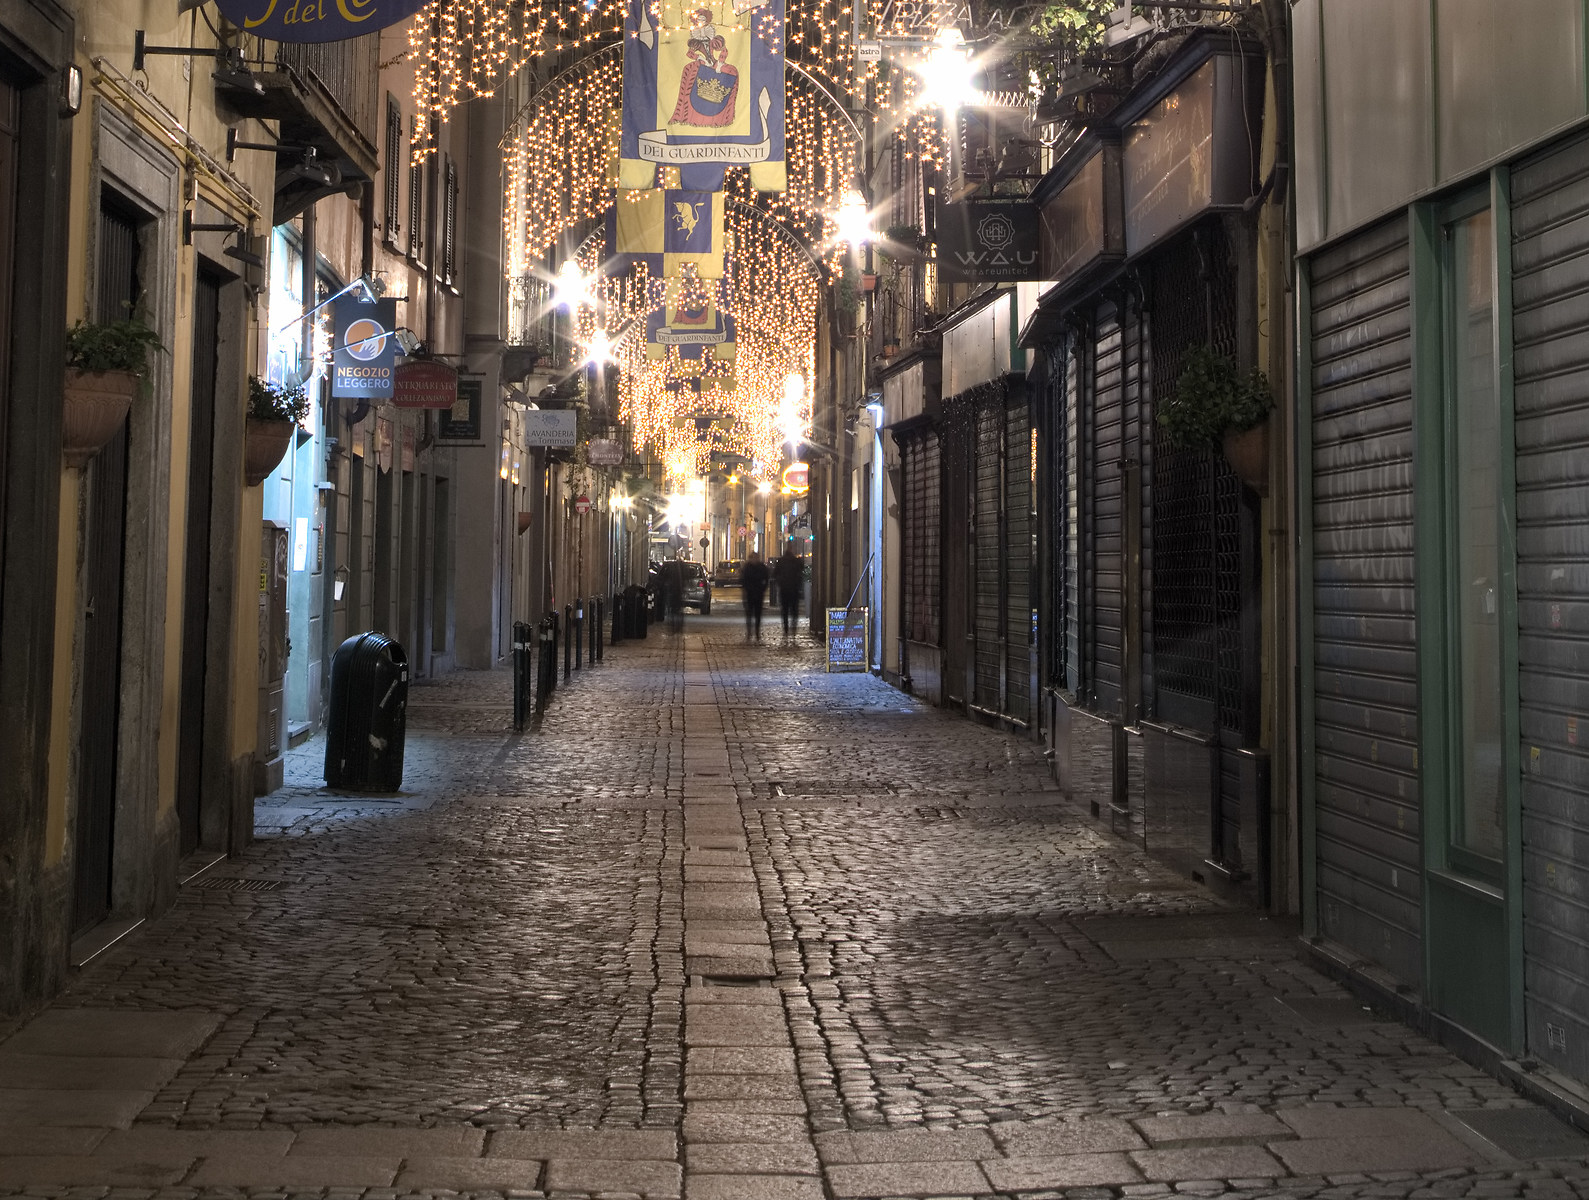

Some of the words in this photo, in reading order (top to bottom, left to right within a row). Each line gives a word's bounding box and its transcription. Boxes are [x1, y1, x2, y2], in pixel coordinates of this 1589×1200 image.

[891, 2, 975, 31] PIZZA
[643, 144, 664, 158] DEI
[668, 146, 765, 160] GUARDINFANTI
[673, 335, 724, 343] GUARDINFANTI
[337, 367, 390, 378] NEGOZIO
[337, 378, 390, 389] LEGGERO
[526, 430, 575, 438] LAVANDERIA
[538, 437, 575, 445] Tommaso
